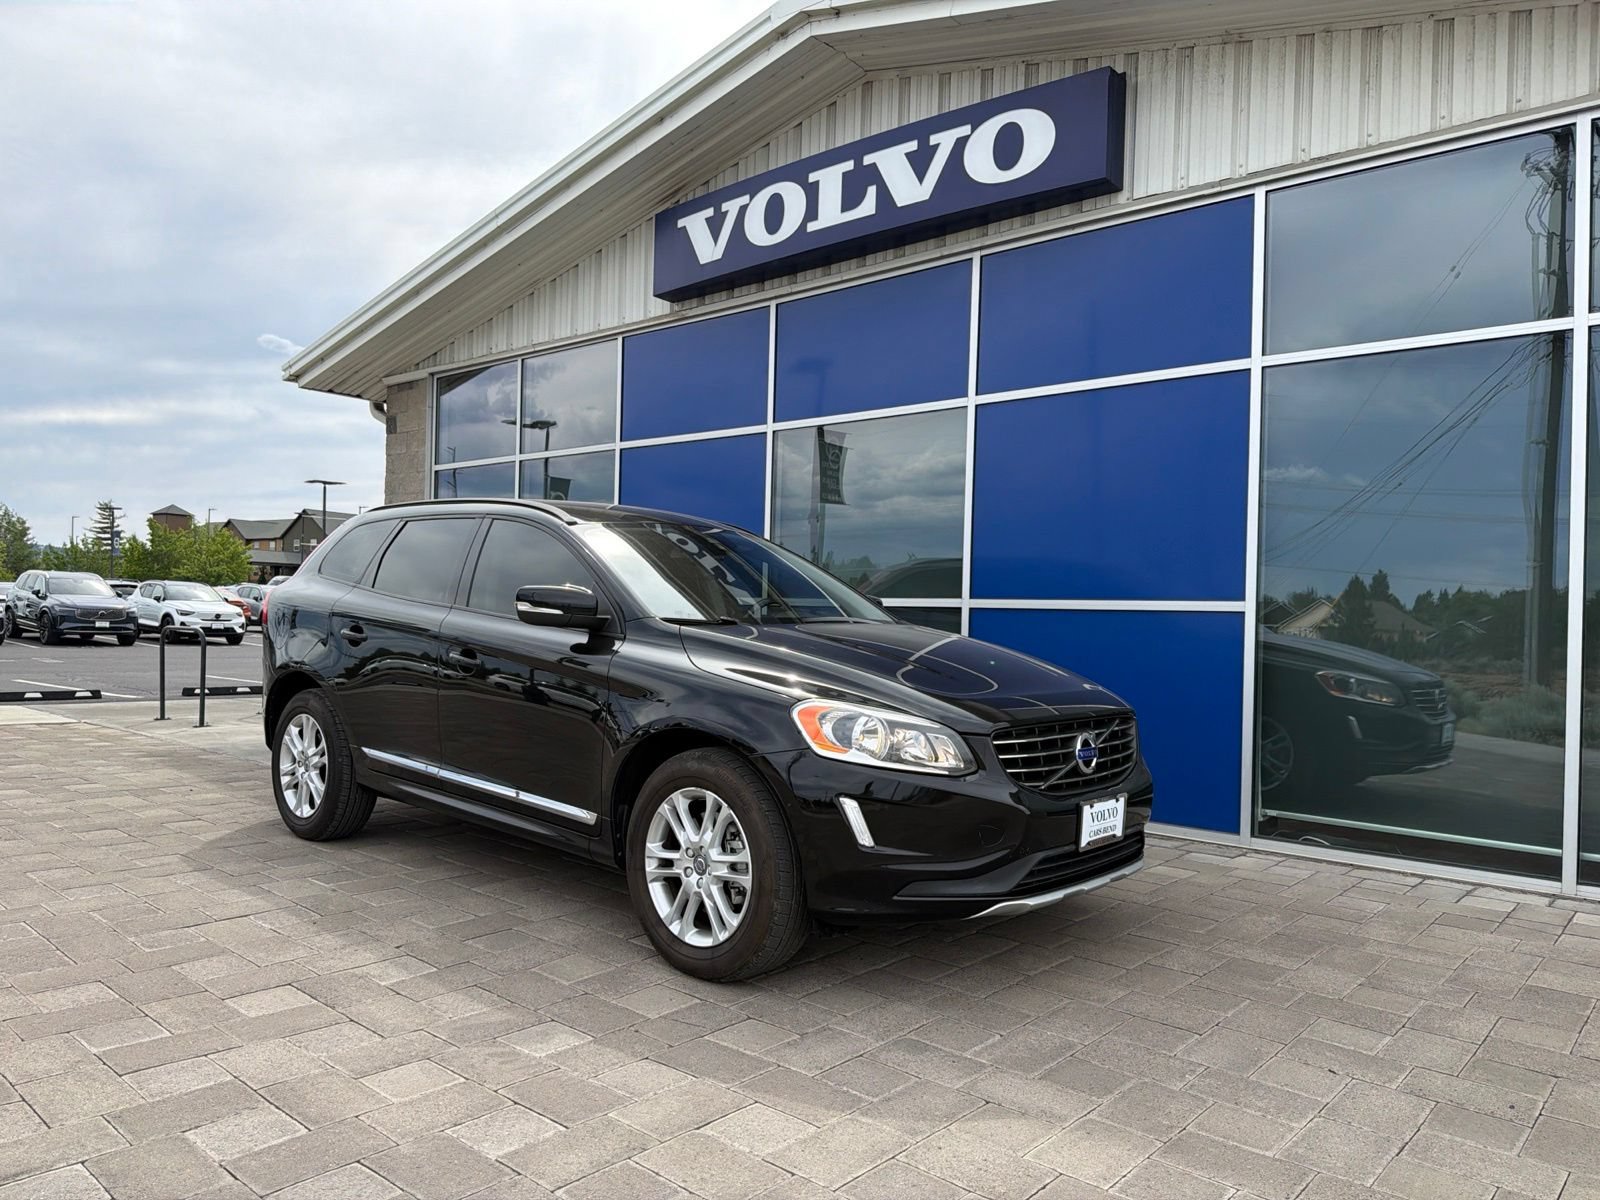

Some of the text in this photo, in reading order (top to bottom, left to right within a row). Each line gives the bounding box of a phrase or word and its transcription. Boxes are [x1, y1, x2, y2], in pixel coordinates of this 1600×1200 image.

[677, 108, 1056, 265] VOLVO
[1090, 806, 1118, 823] VOLVO
[1089, 824, 1117, 839] CARS BEND
